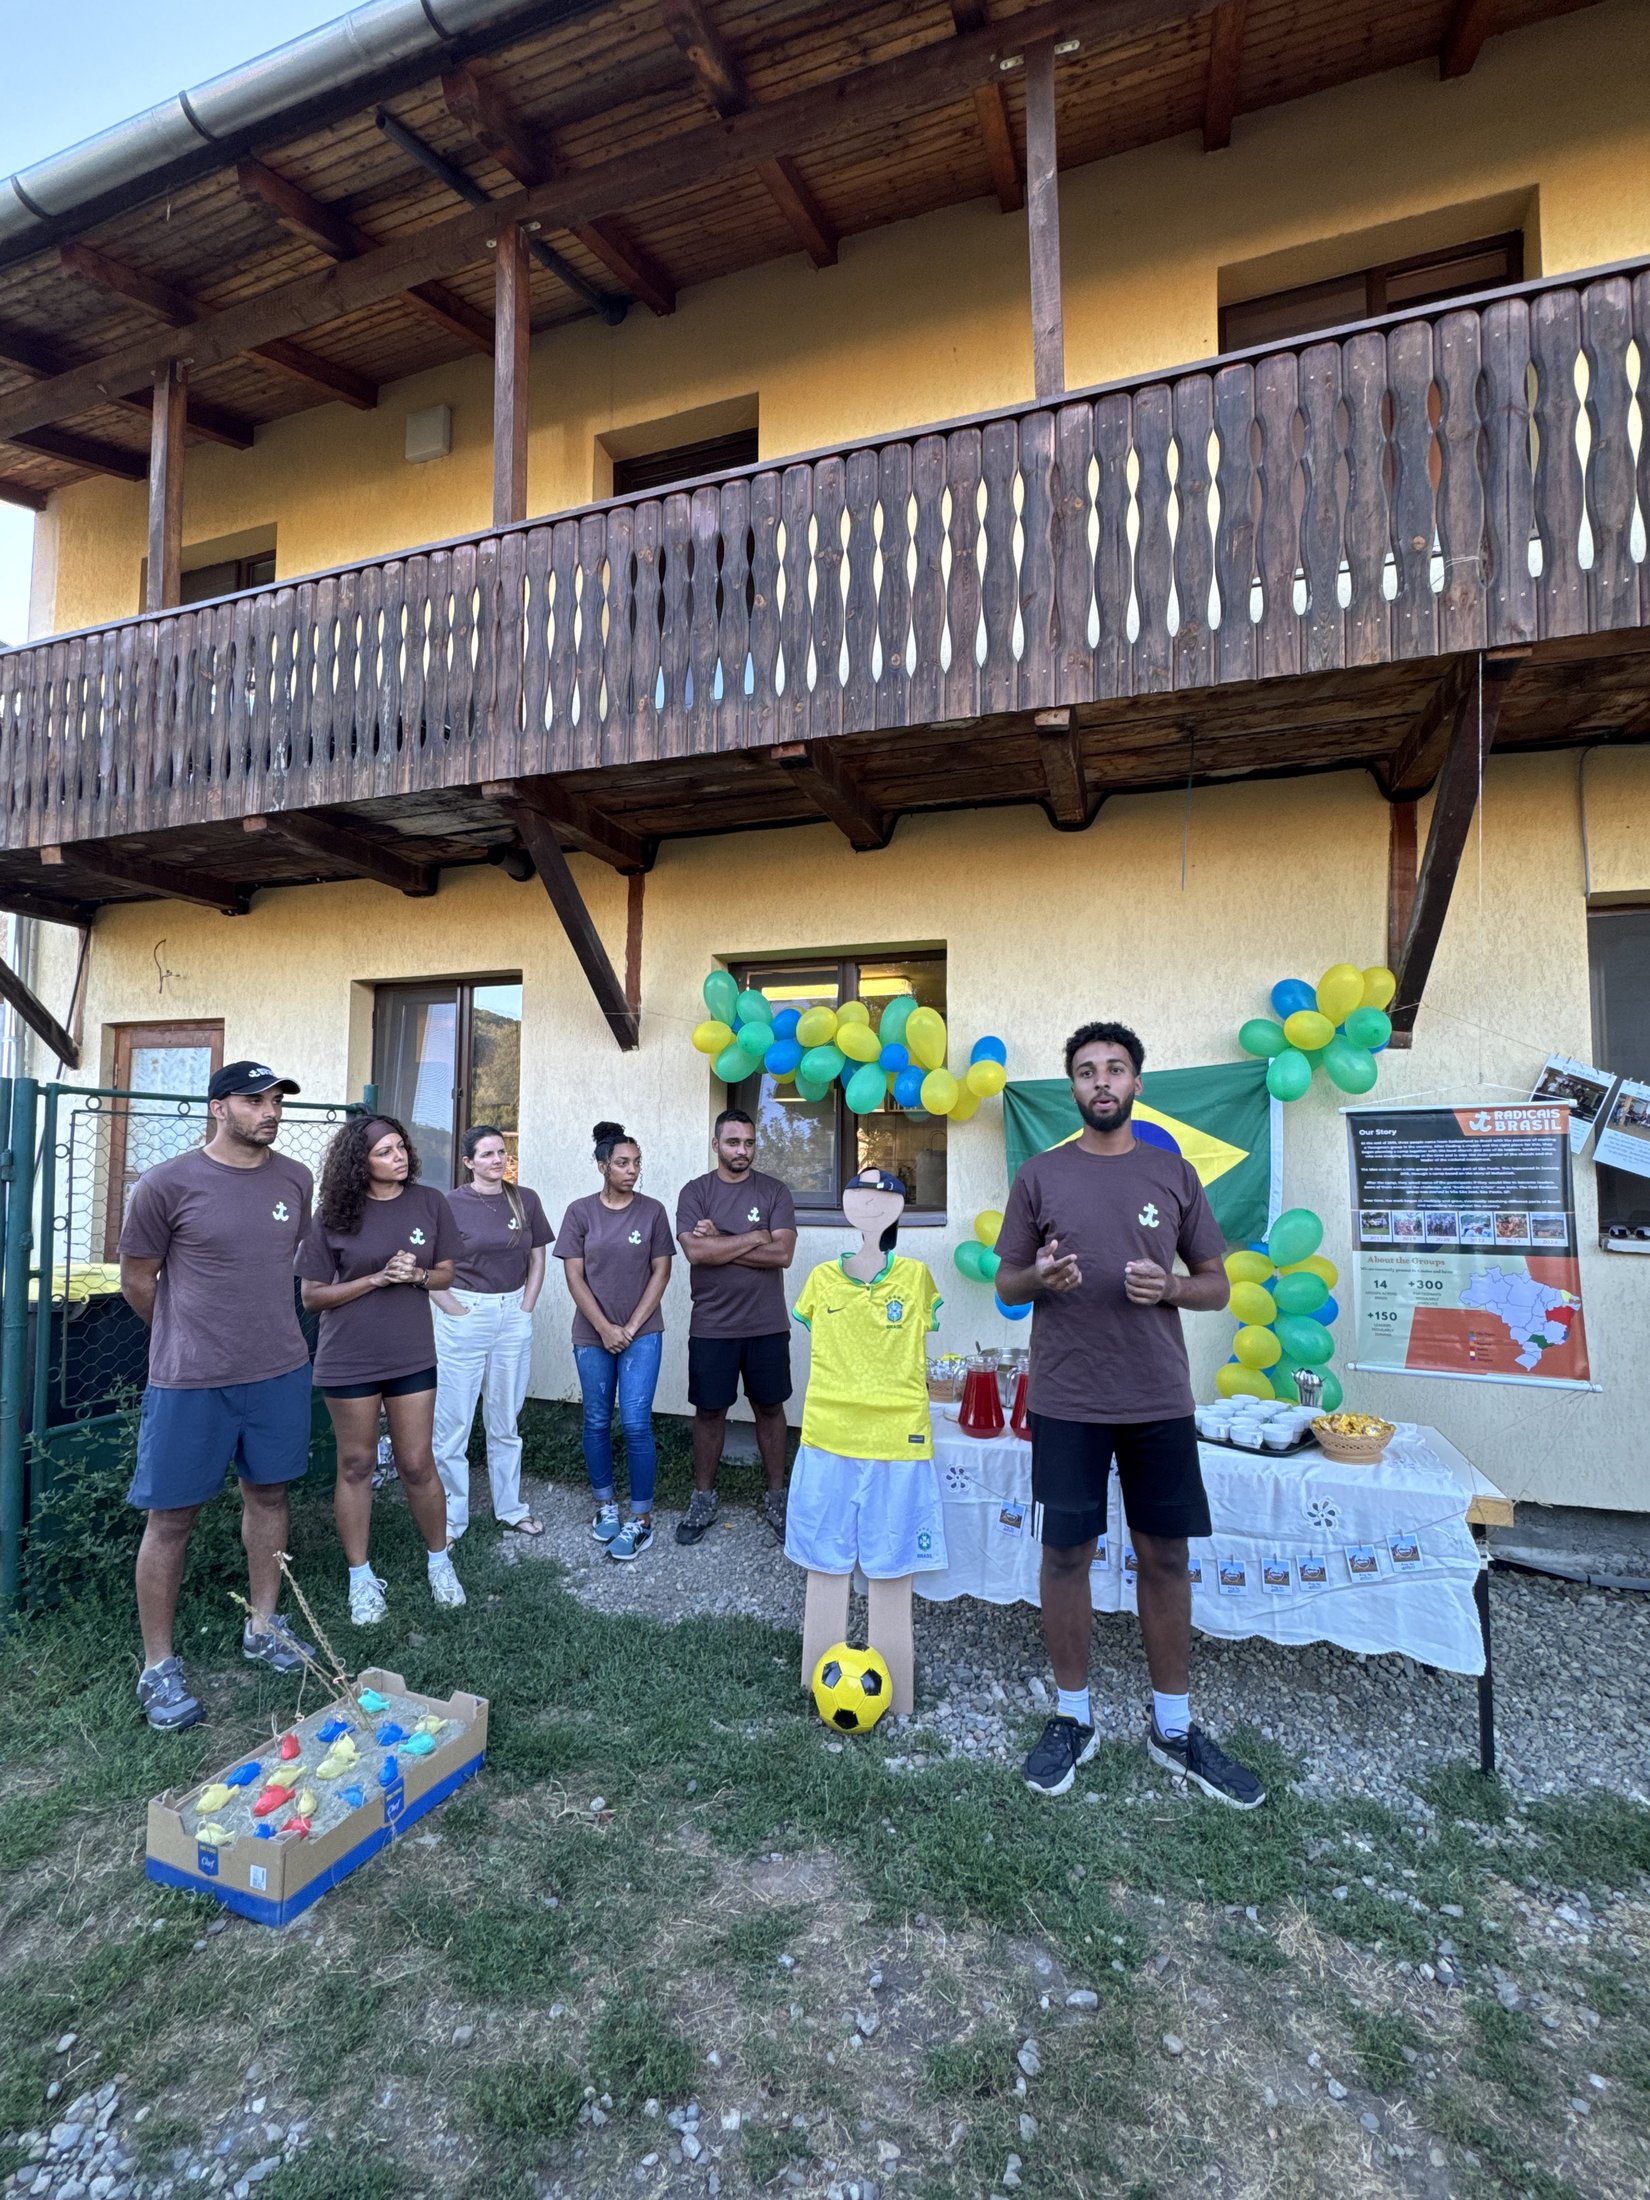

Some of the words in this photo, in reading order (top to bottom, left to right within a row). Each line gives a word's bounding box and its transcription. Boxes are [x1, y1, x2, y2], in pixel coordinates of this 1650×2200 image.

[1494, 1108, 1561, 1120] RADICAIS
[1494, 1119, 1562, 1131] BRASIL
[1375, 1128, 1397, 1136] Story
[1367, 1256, 1394, 1264] About
[1395, 1256, 1410, 1264] the
[1411, 1257, 1446, 1268] Groups
[1374, 1280, 1388, 1289] 14
[1408, 1280, 1443, 1290] +300
[1367, 1311, 1398, 1321] +150
